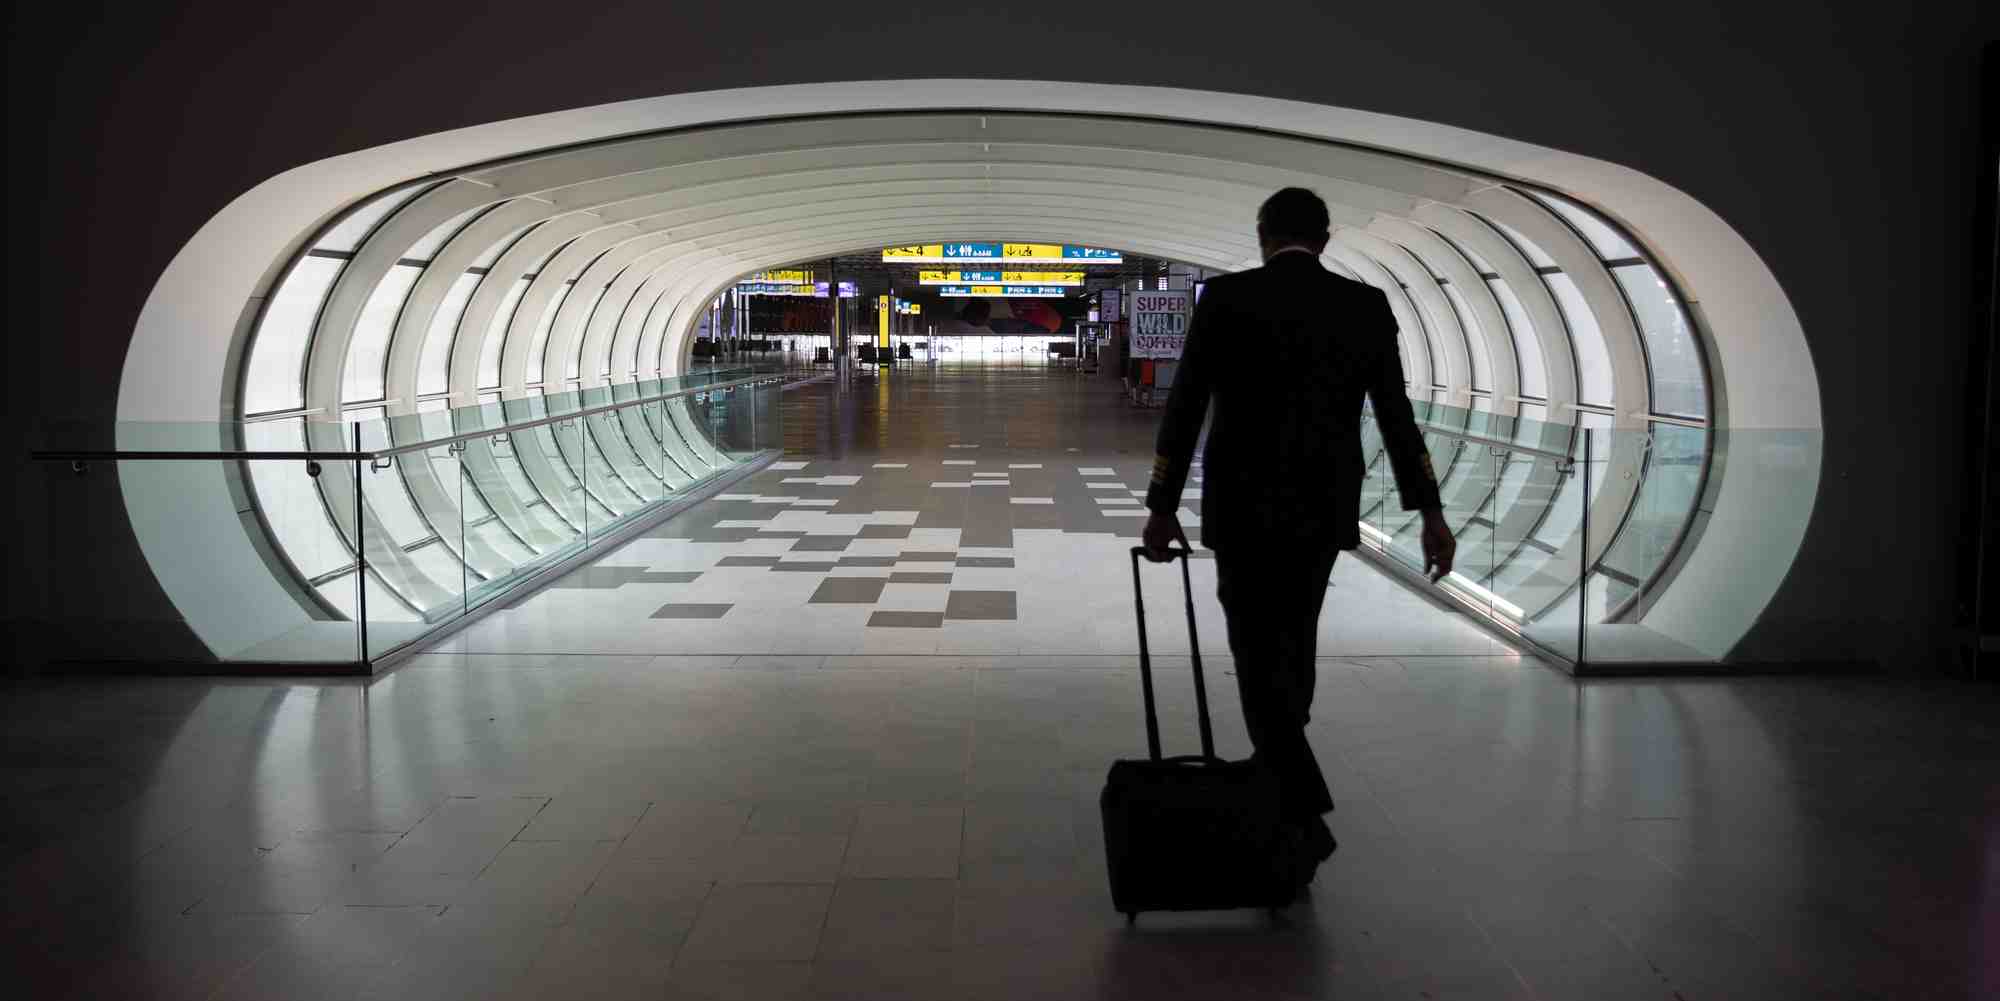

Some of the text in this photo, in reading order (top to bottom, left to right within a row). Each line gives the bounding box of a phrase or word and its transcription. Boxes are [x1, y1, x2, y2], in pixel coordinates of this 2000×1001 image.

[916, 246, 923, 256] 4
[1137, 296, 1185, 312] SUPER
[1138, 313, 1185, 334] WILD
